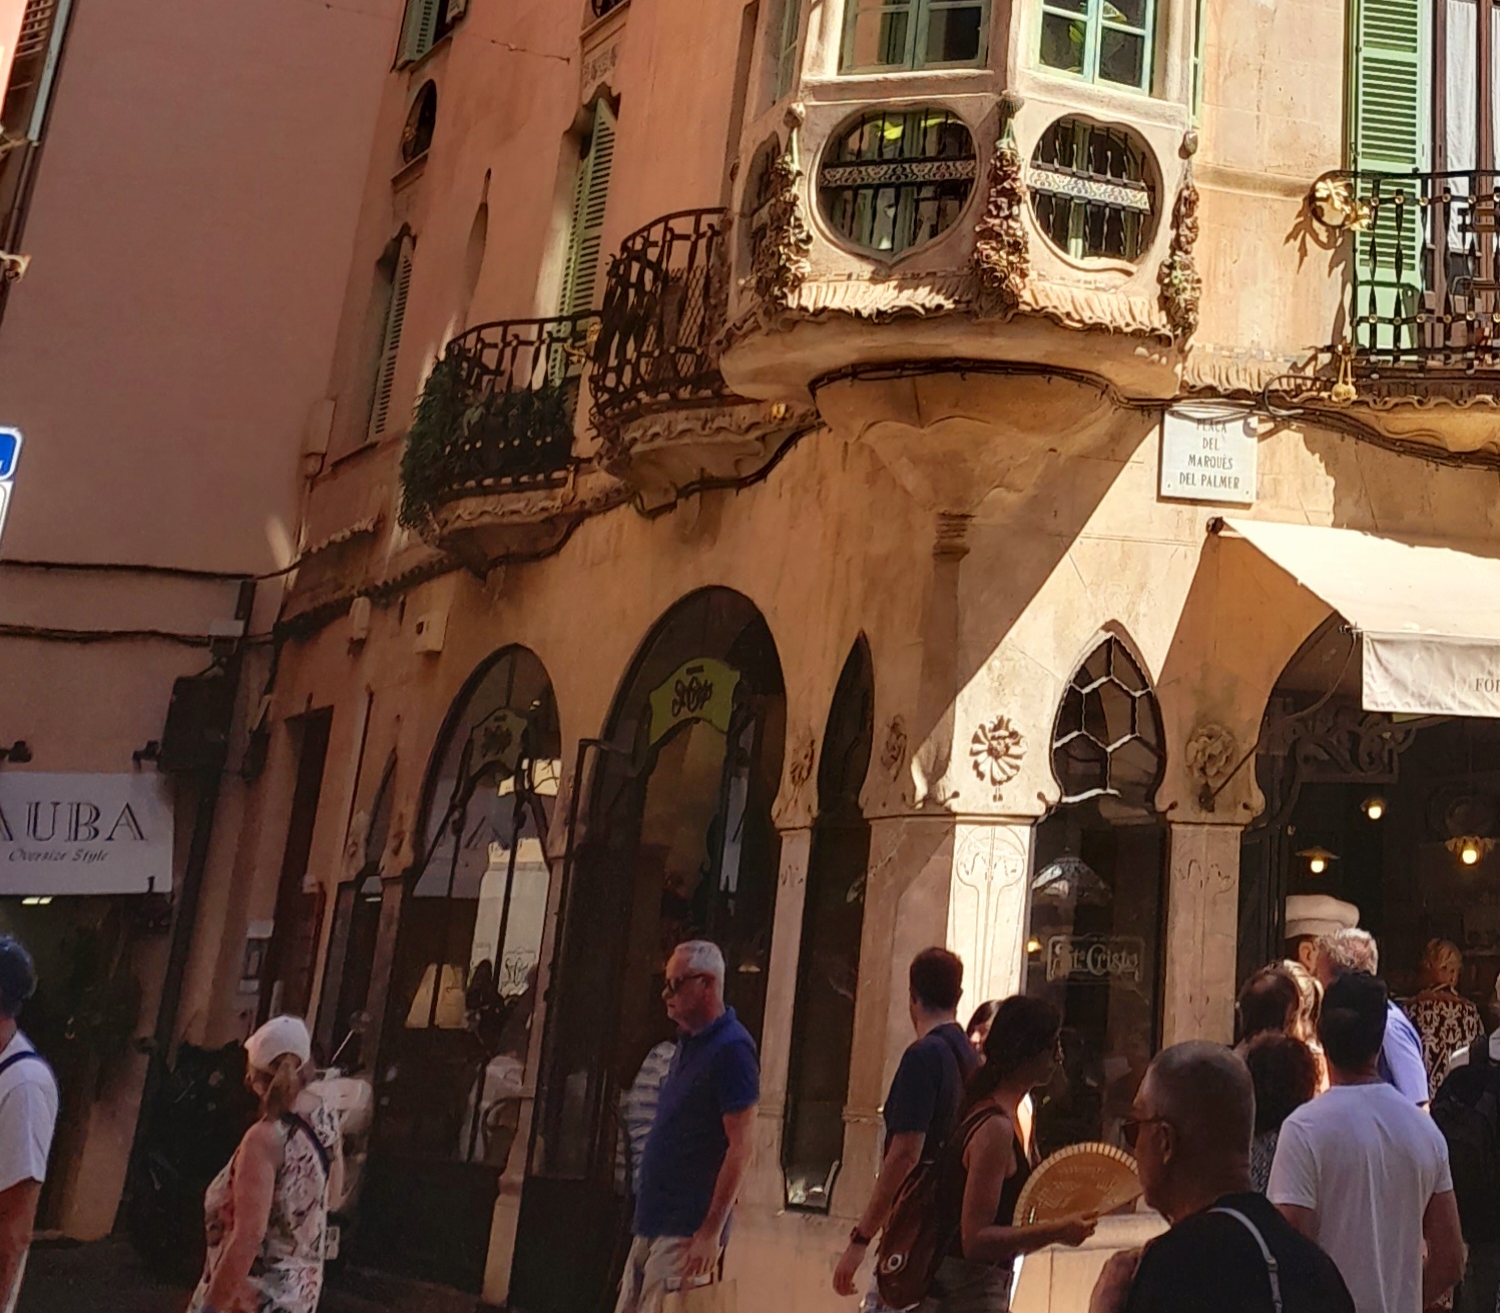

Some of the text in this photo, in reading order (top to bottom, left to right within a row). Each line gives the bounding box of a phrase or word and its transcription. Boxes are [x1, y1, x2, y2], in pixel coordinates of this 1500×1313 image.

[1202, 437, 1220, 451] DEL
[1179, 471, 1240, 490] DEL PALMER
[72, 848, 109, 864] Style
